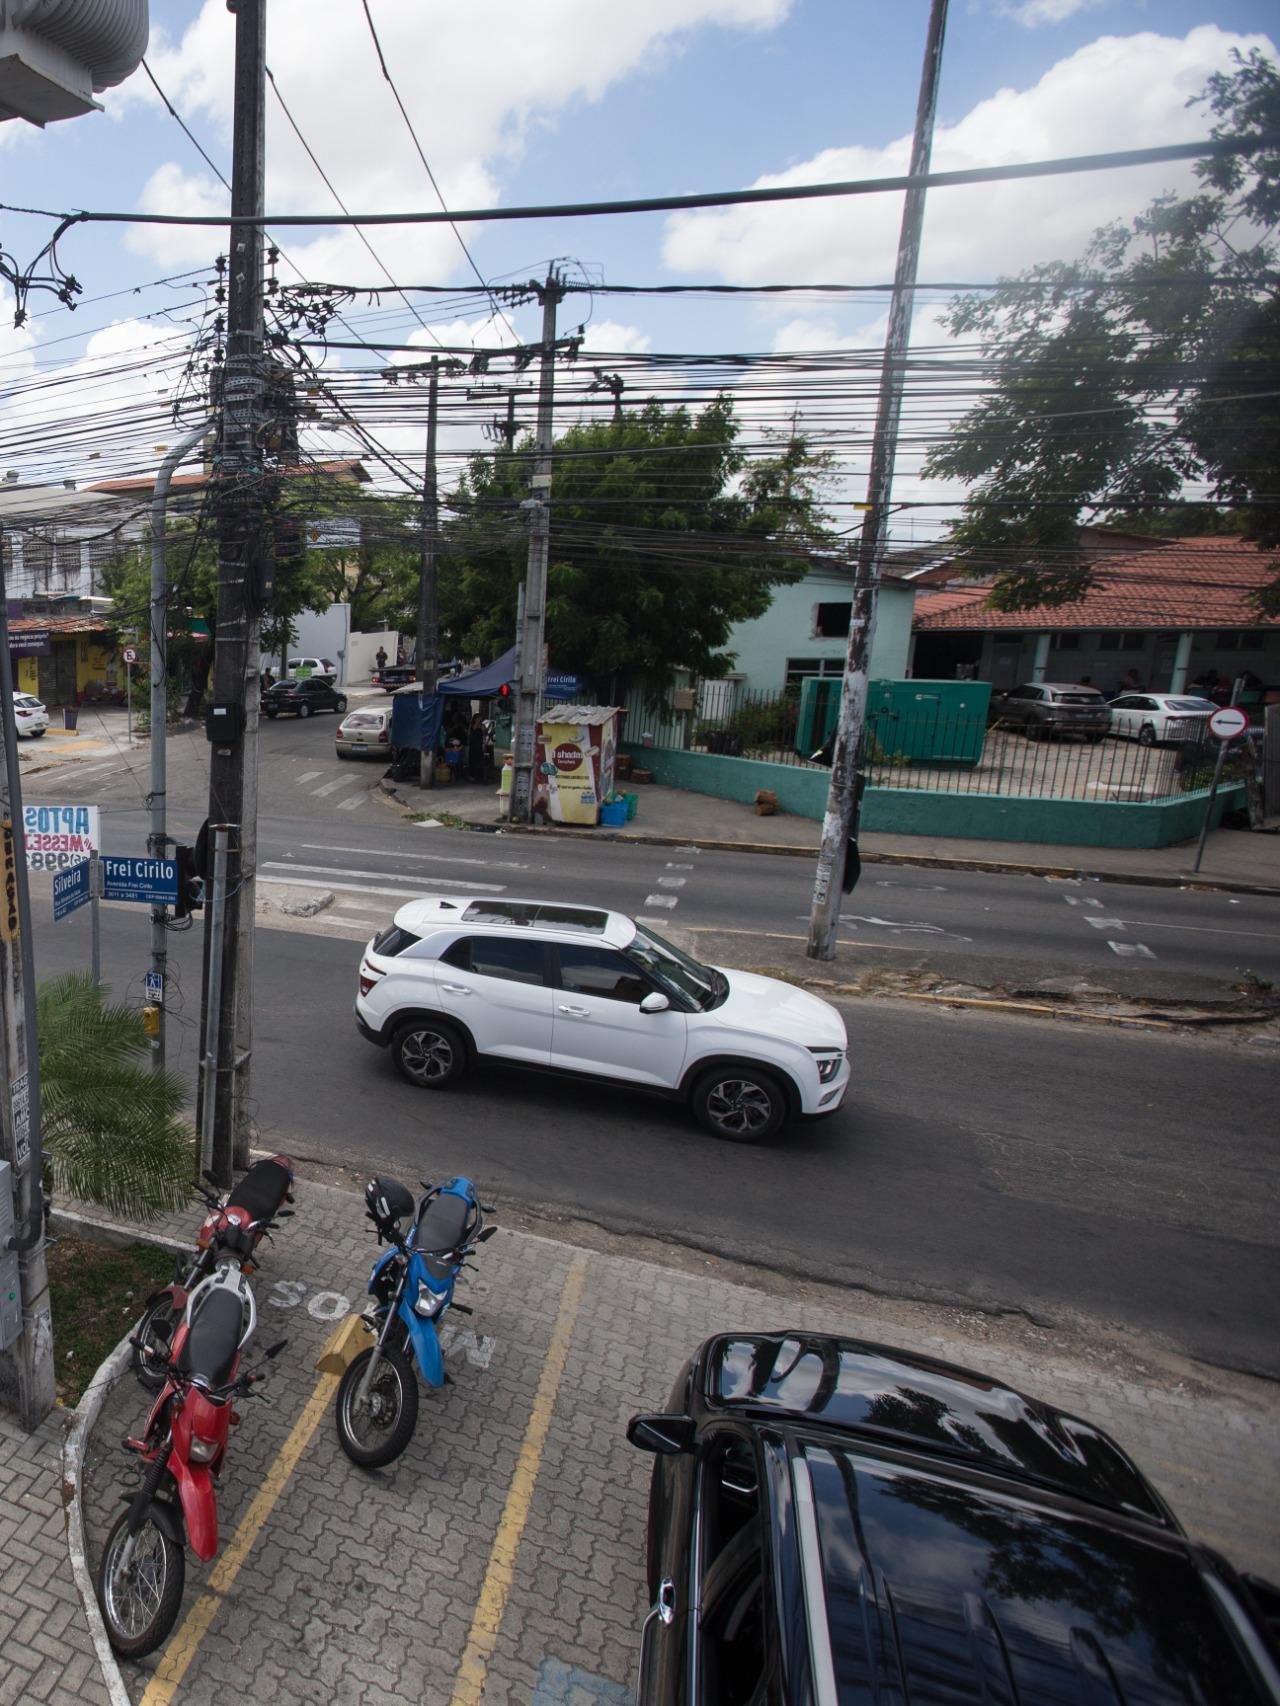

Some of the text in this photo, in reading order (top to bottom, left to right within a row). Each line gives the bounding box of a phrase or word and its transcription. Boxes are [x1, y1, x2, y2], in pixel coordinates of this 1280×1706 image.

[106, 860, 174, 879] Frei Cirilo
[54, 869, 81, 895] Silveira
